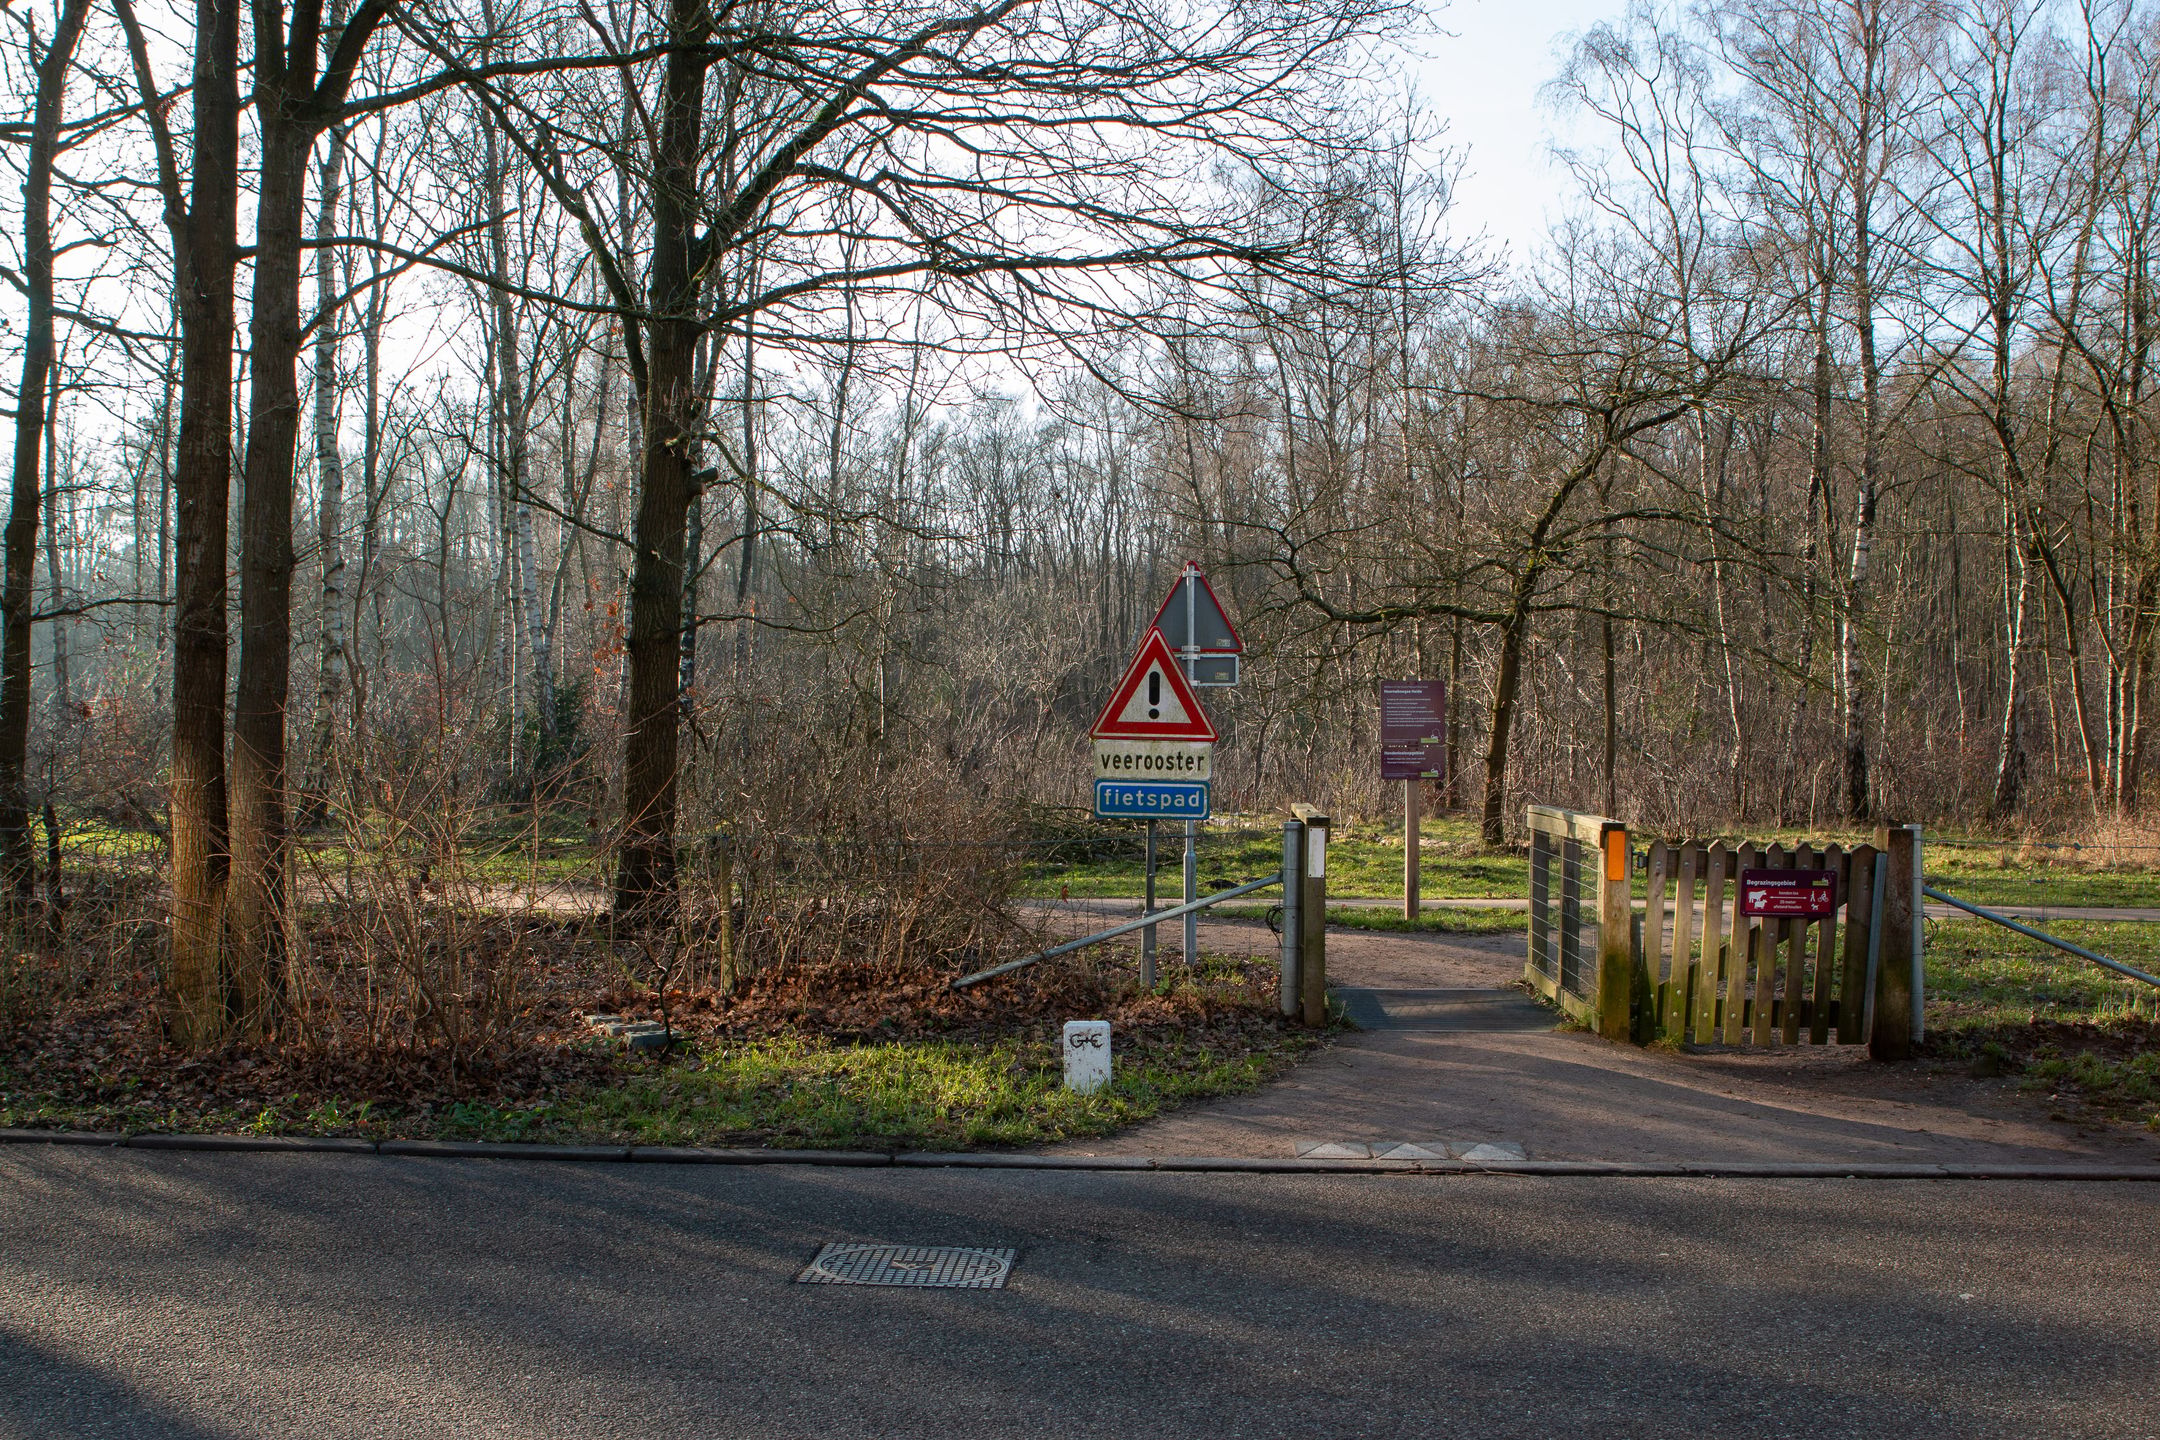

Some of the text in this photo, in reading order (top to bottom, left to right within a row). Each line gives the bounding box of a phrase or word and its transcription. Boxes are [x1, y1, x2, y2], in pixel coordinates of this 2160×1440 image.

[1100, 751, 1205, 771] veerooster
[1104, 788, 1200, 810] fietspad
[1746, 879, 1796, 887] Begrazingsgebied
